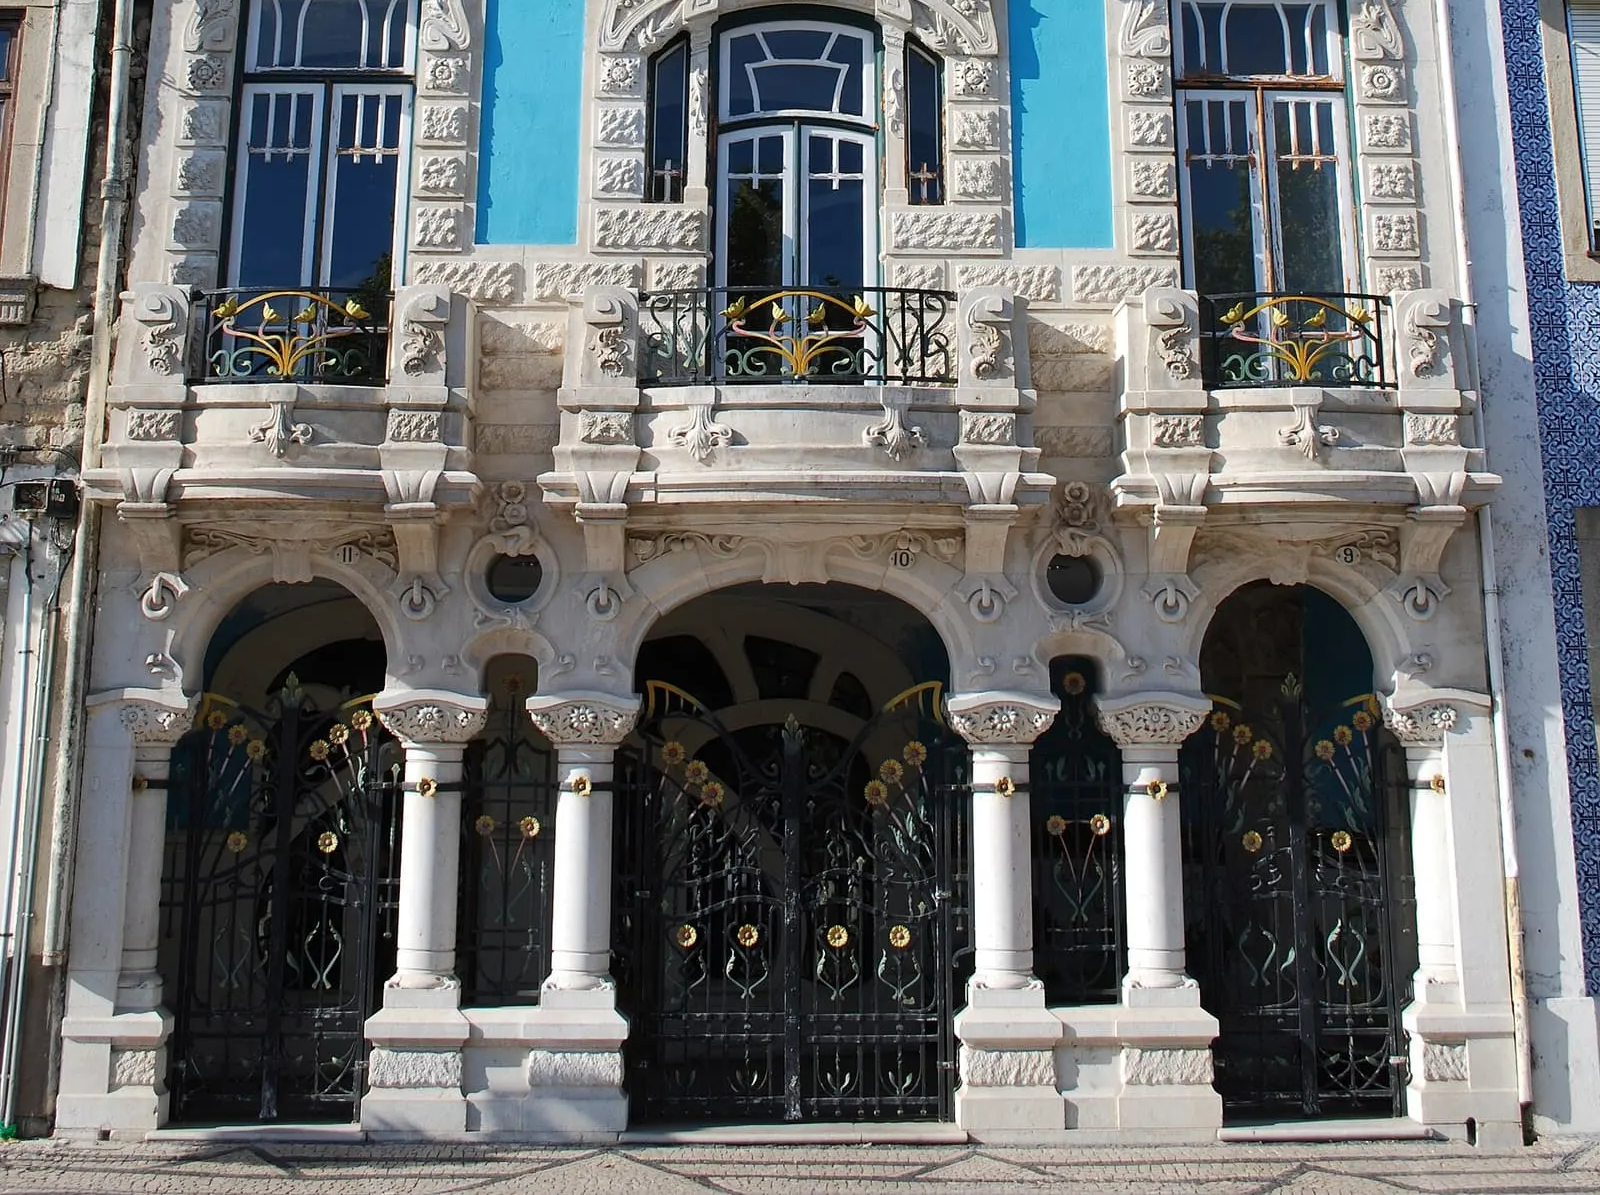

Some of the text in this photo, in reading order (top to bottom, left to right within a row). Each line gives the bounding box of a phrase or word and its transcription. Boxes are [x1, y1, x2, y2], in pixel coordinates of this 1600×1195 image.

[343, 547, 352, 562] 11
[894, 551, 910, 566] 10
[1343, 547, 1354, 563] 9
